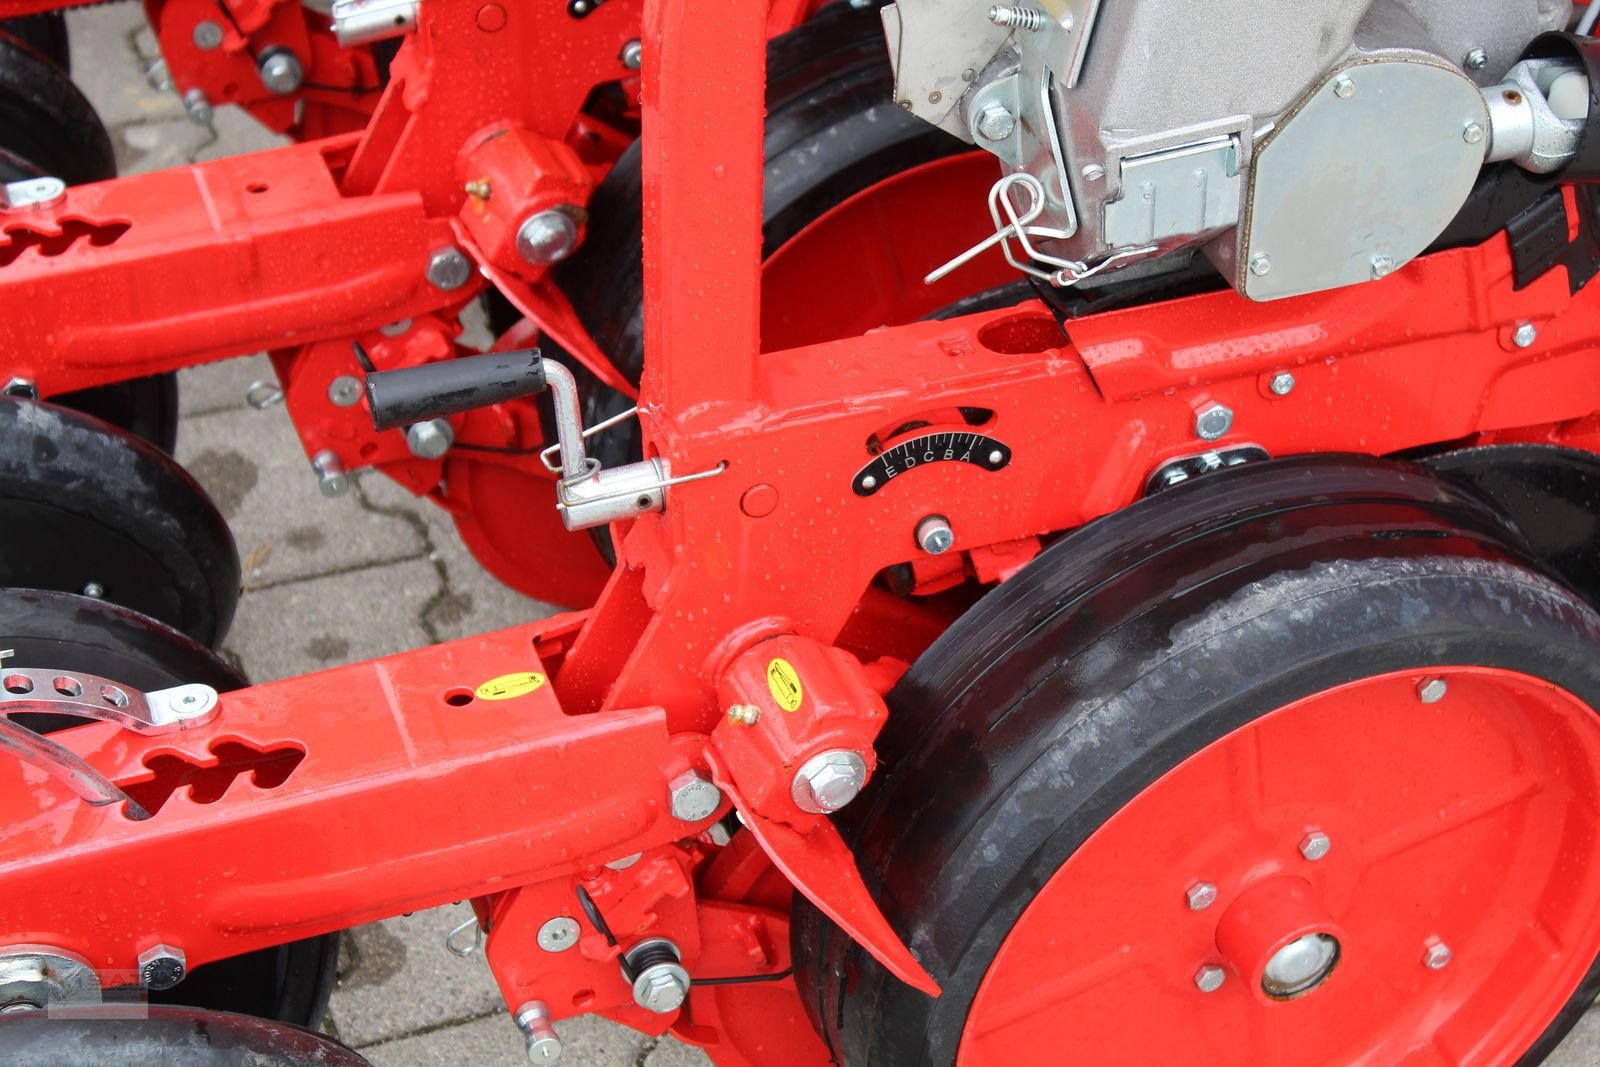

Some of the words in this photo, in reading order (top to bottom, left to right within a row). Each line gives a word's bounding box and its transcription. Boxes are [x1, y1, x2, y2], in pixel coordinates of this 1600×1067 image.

[885, 466, 898, 478] E
[904, 456, 916, 468] D
[923, 451, 935, 462] C
[943, 449, 954, 460] B
[959, 451, 971, 462] A
